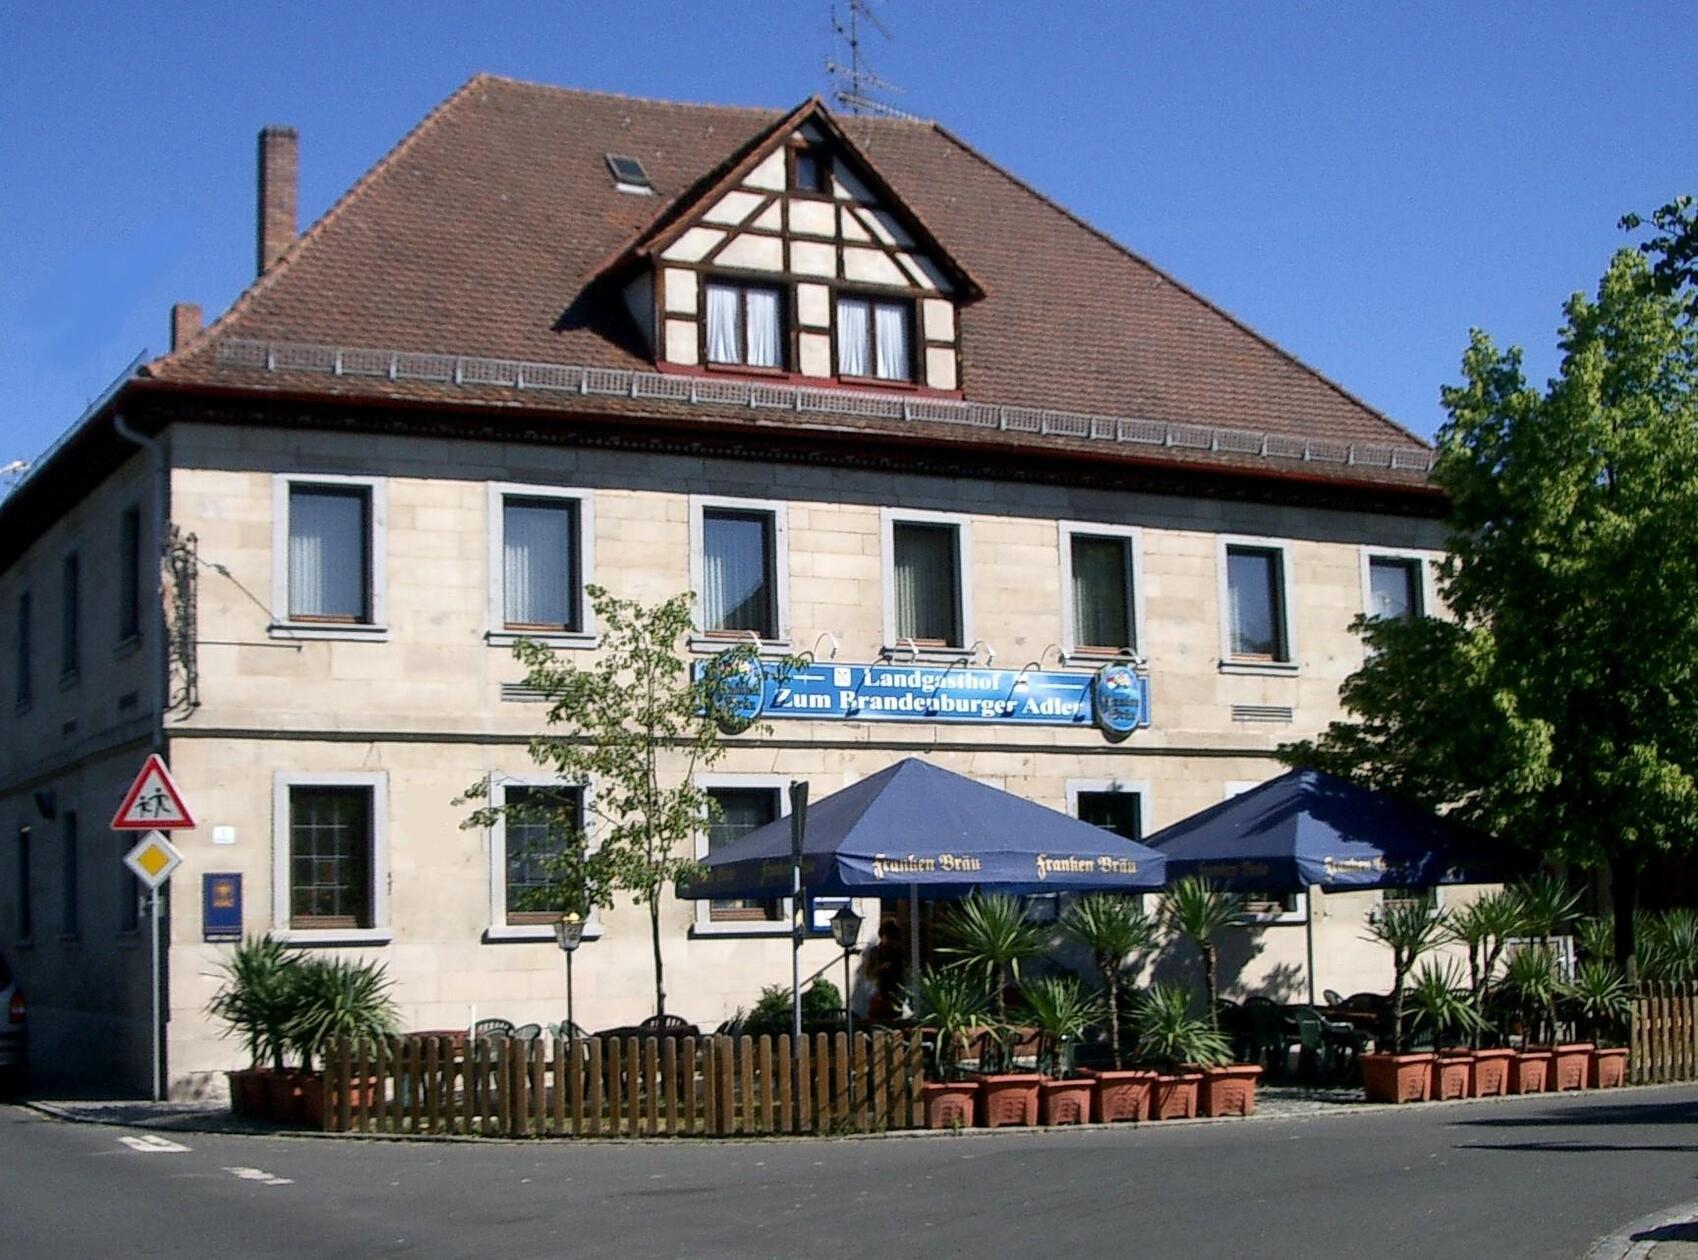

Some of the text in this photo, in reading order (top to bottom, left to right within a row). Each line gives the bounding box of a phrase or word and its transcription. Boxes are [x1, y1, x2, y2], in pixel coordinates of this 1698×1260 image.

[863, 668, 1001, 693] Landgasthof
[774, 688, 832, 709] Zum
[839, 690, 1018, 718] Brandenburger
[1021, 696, 1084, 716] Adler
[872, 854, 982, 880] Franken Bräu
[1035, 853, 1138, 880] Franken Bräu
